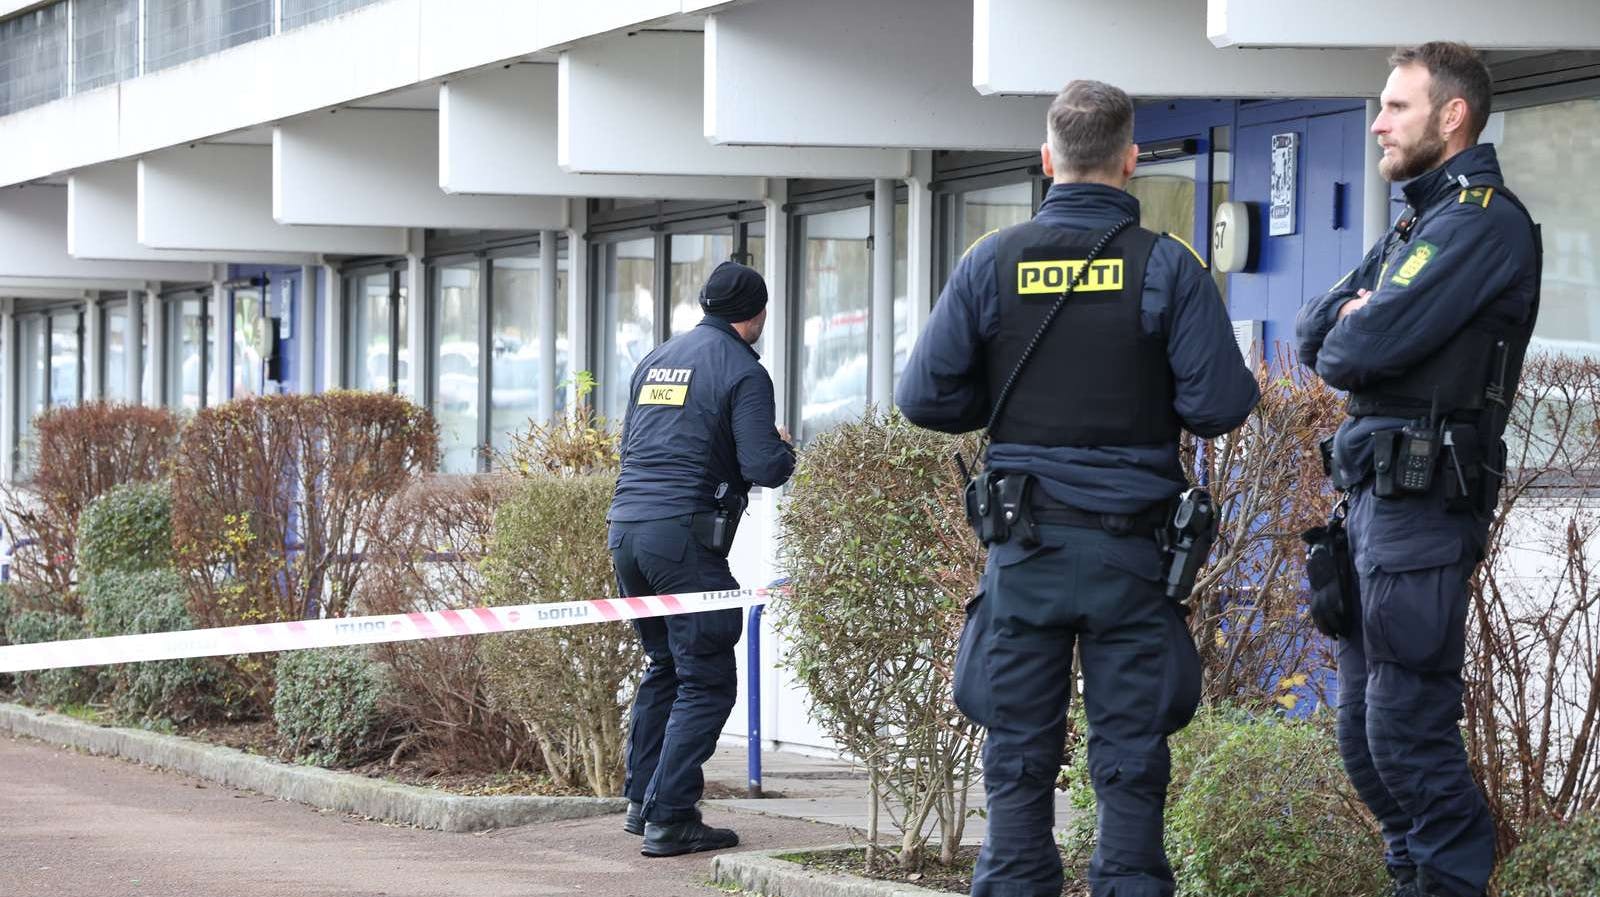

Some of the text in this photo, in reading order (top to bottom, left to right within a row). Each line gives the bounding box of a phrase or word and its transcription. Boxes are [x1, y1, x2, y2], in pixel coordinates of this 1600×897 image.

[1215, 221, 1226, 249] 57
[1021, 264, 1120, 288] POLITI
[646, 368, 692, 382] POLITI
[650, 388, 673, 400] NKC
